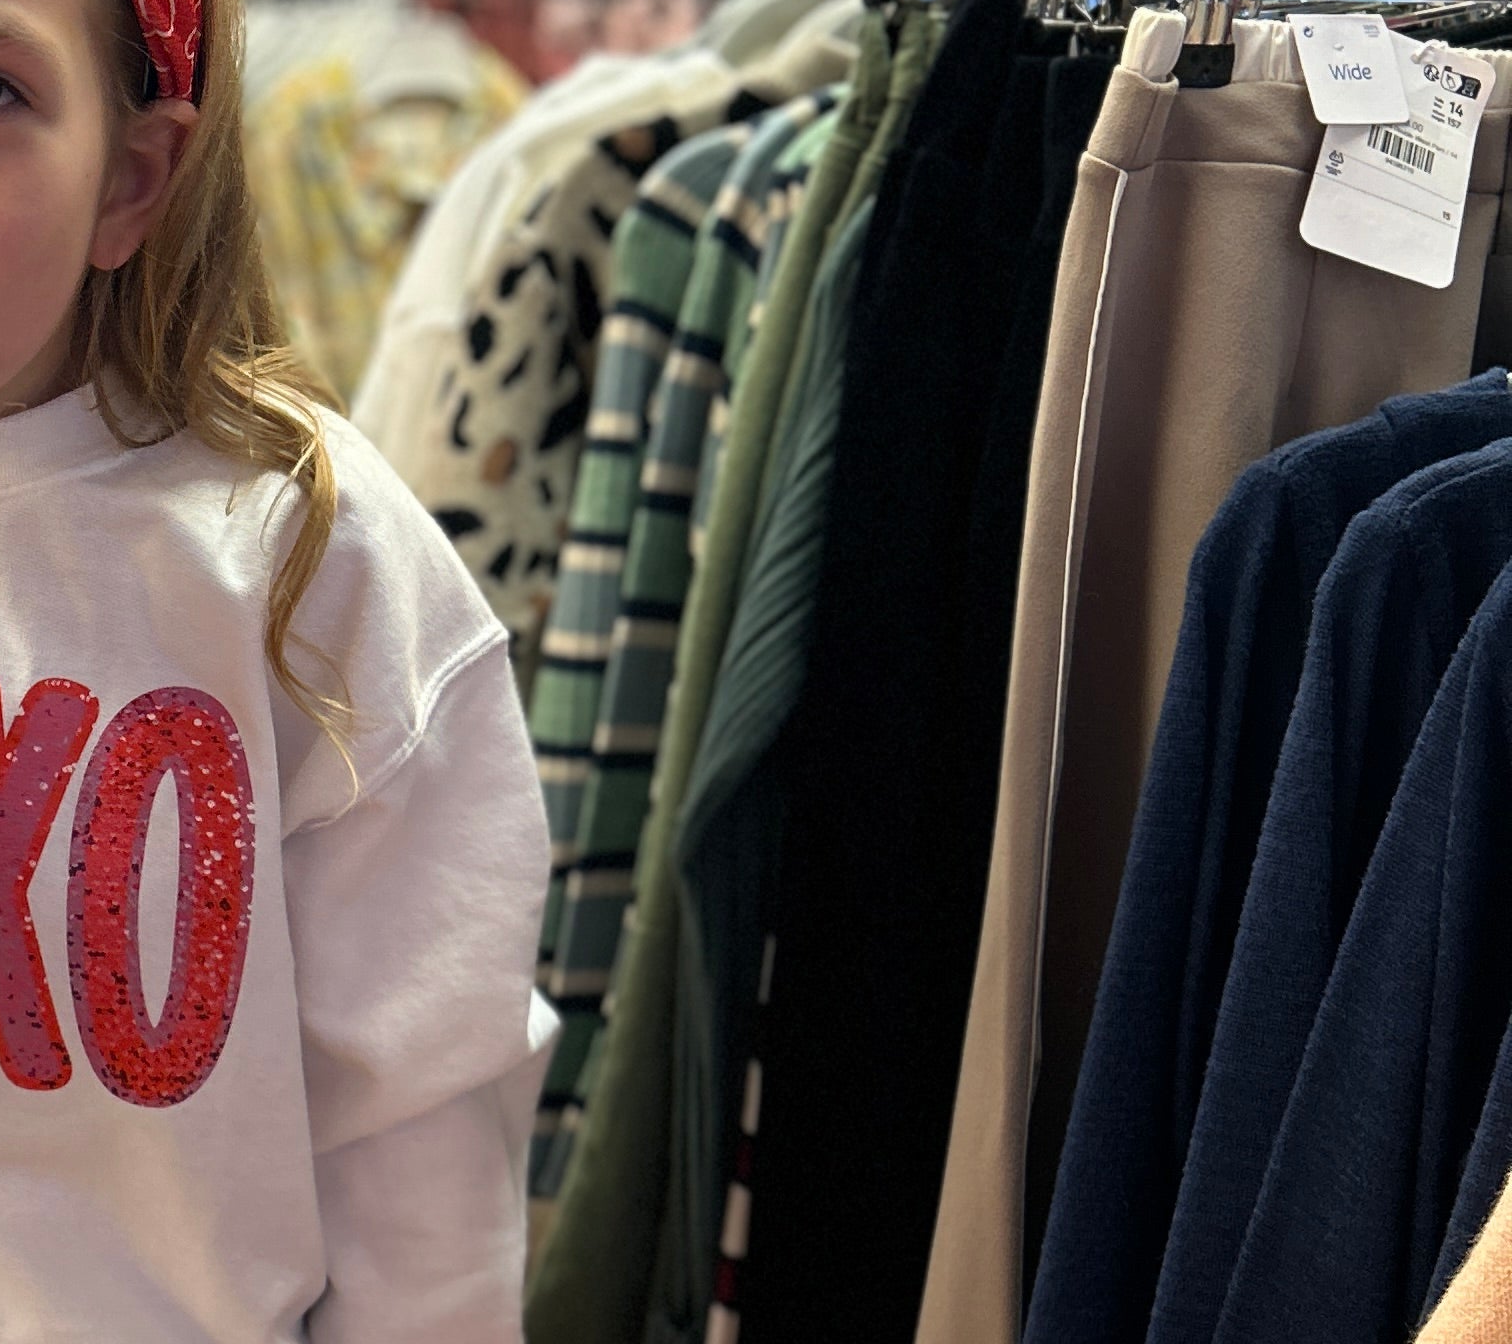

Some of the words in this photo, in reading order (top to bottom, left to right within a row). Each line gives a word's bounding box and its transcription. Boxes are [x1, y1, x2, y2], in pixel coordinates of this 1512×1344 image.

[1328, 63, 1372, 80] Wide
[1450, 102, 1463, 117] 14
[1448, 117, 1461, 129] 157
